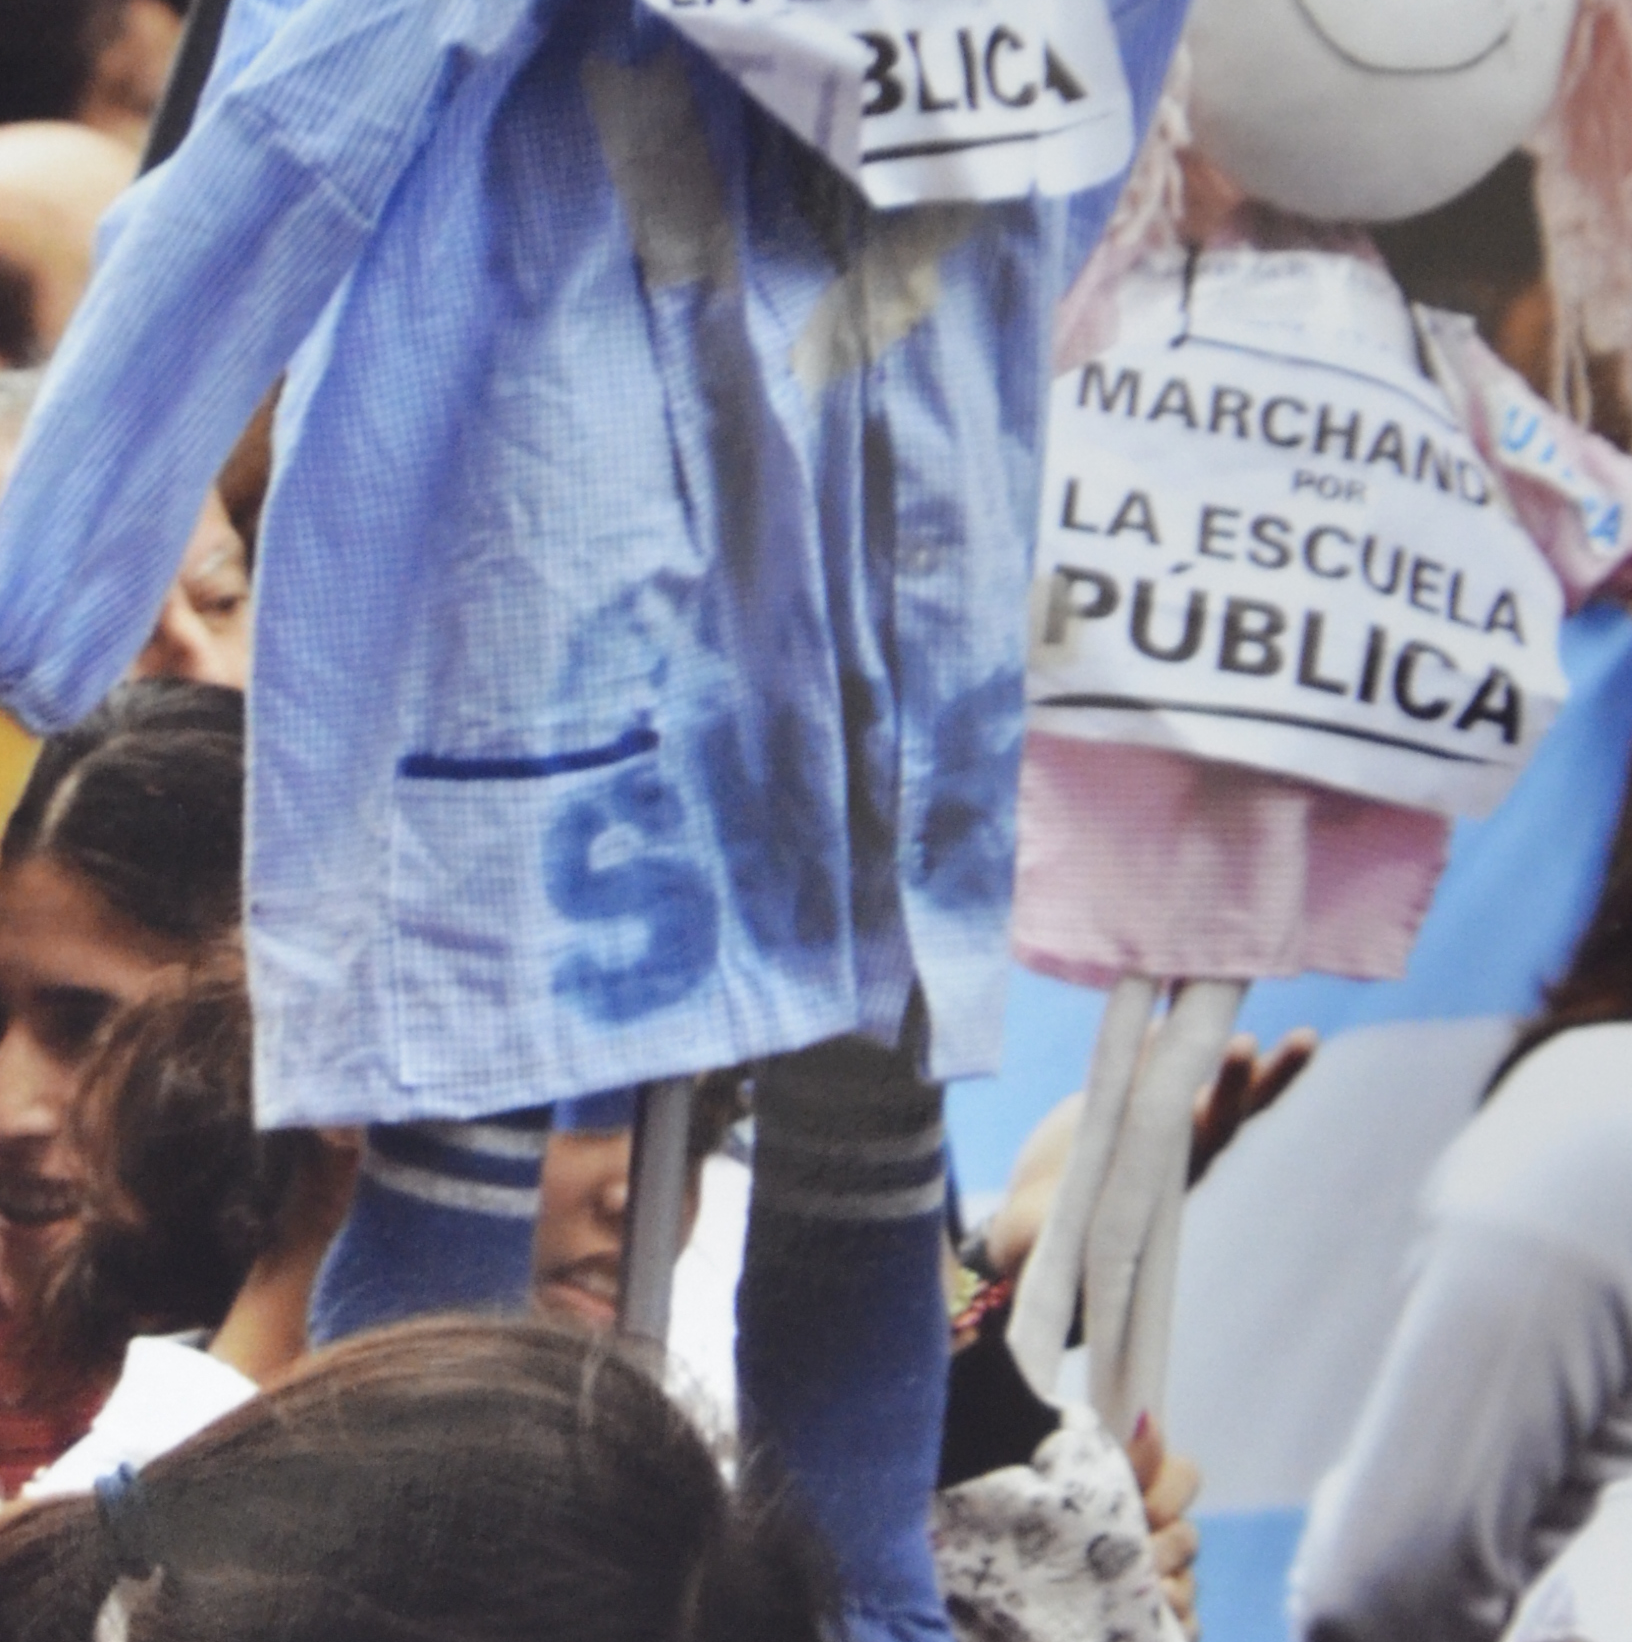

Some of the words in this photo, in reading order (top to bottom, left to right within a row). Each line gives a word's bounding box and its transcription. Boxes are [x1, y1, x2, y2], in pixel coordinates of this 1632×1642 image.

[852, 23, 1088, 118] BLICA
[1076, 360, 1492, 508] MARCHAND
[1290, 470, 1368, 504] POR
[1059, 478, 1161, 546] LA
[1196, 504, 1527, 646] ESCUELA
[1043, 560, 1521, 745] PÚBLICA
